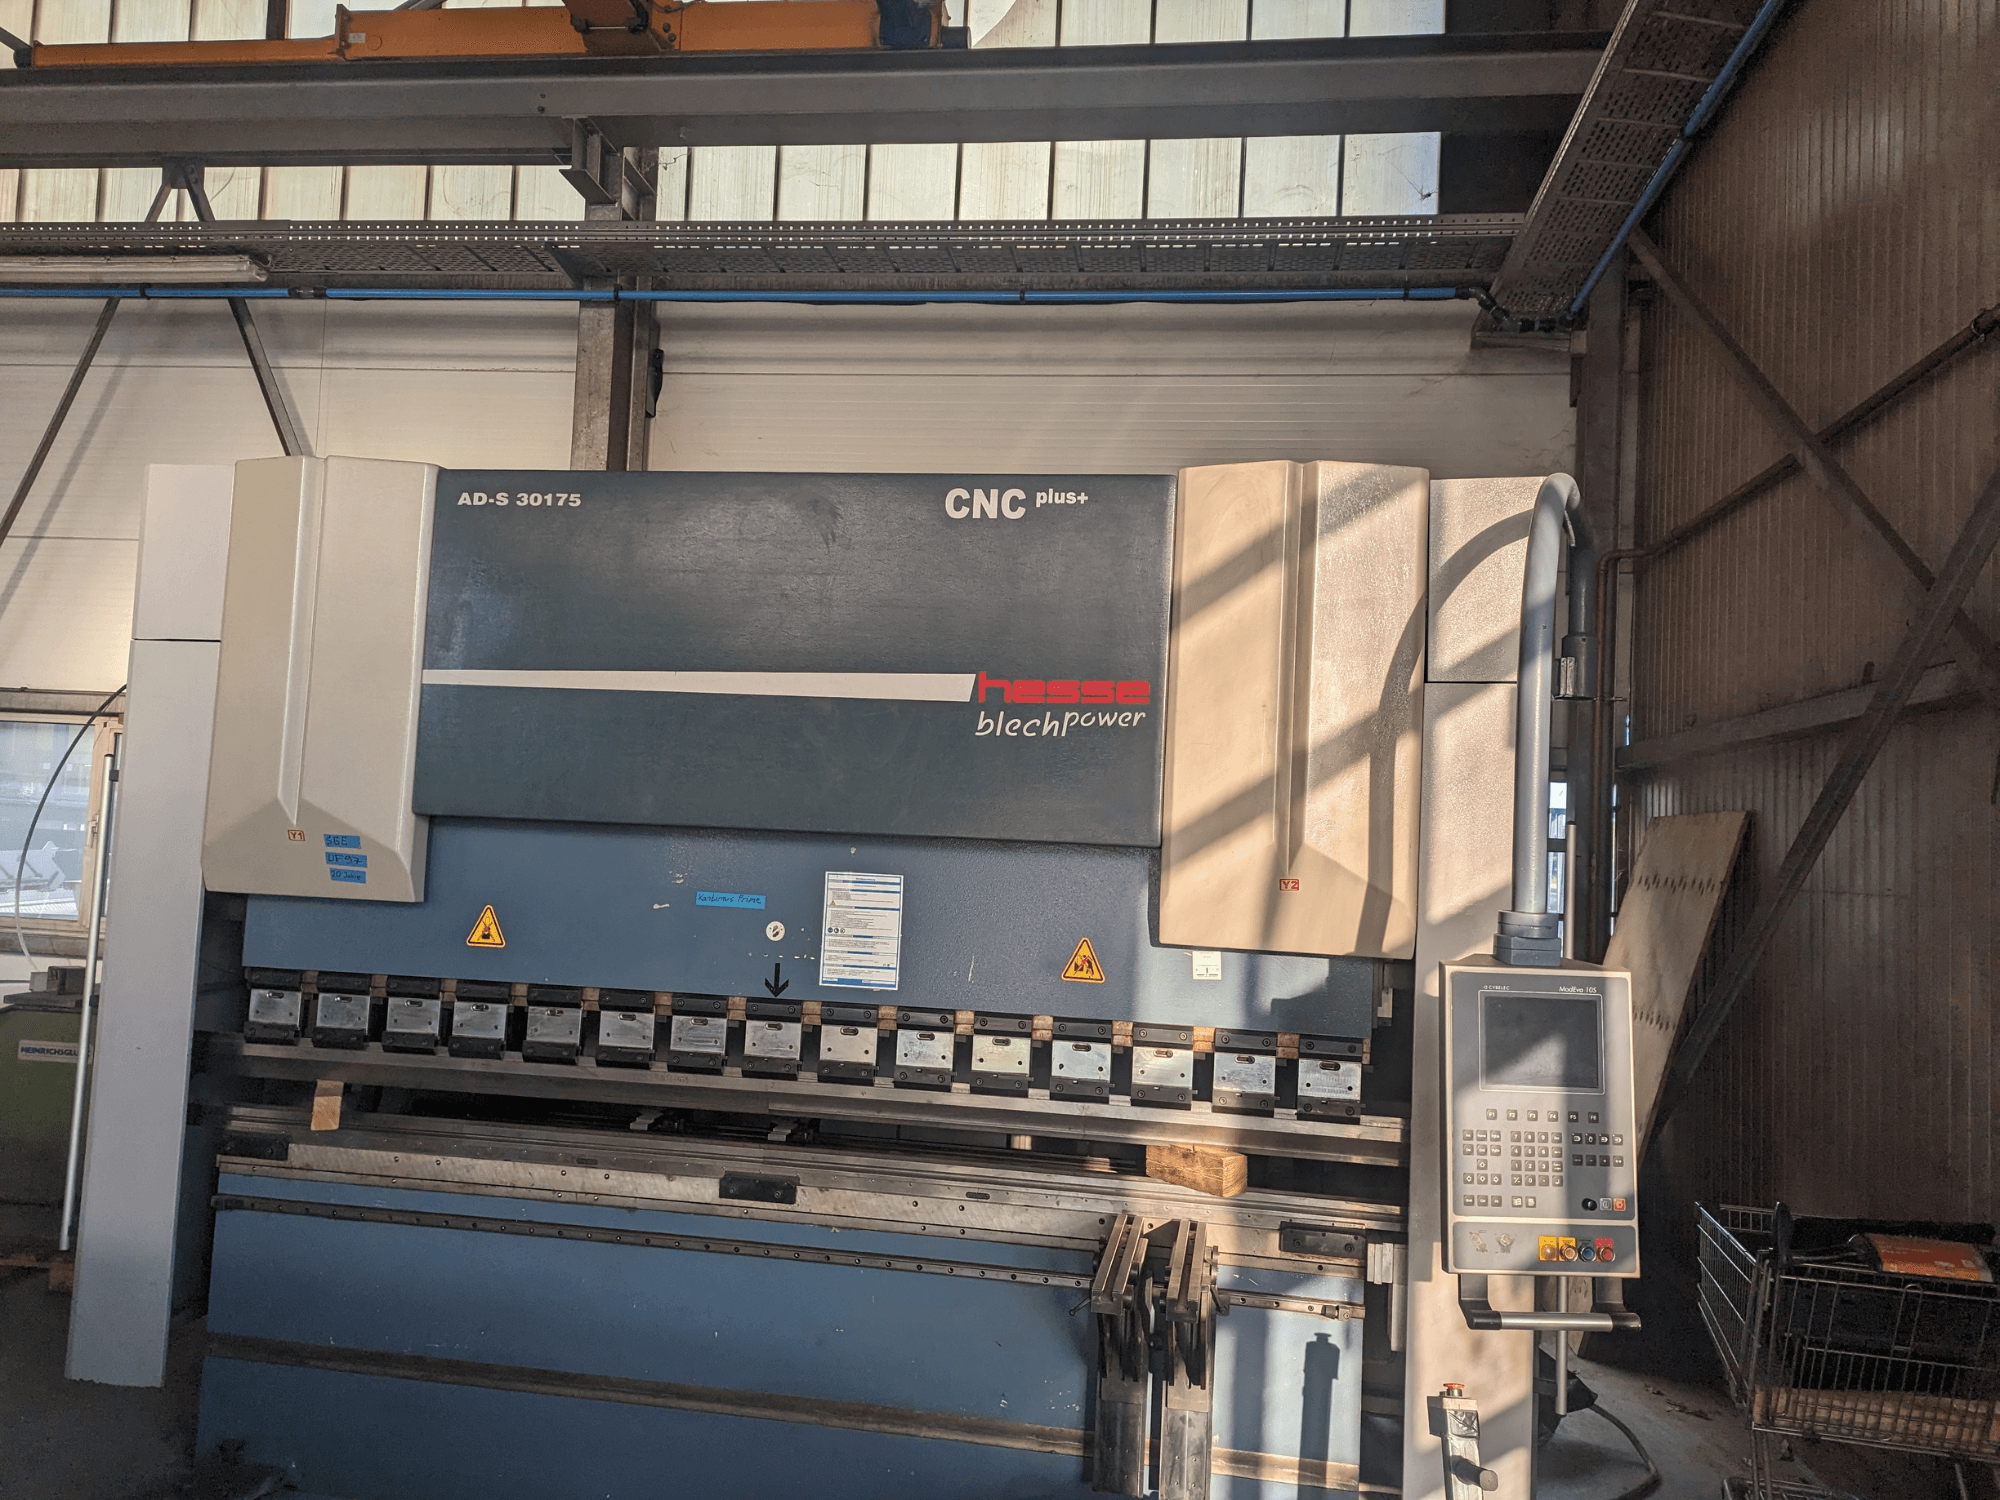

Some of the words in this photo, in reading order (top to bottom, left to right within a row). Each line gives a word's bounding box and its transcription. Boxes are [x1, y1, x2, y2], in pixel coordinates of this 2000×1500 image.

[457, 492, 509, 506] AD-S
[515, 493, 582, 507] 30175
[945, 488, 1027, 519] CNC
[1035, 488, 1089, 508] plus+
[978, 671, 1150, 705] hesse
[290, 831, 303, 840] Y1
